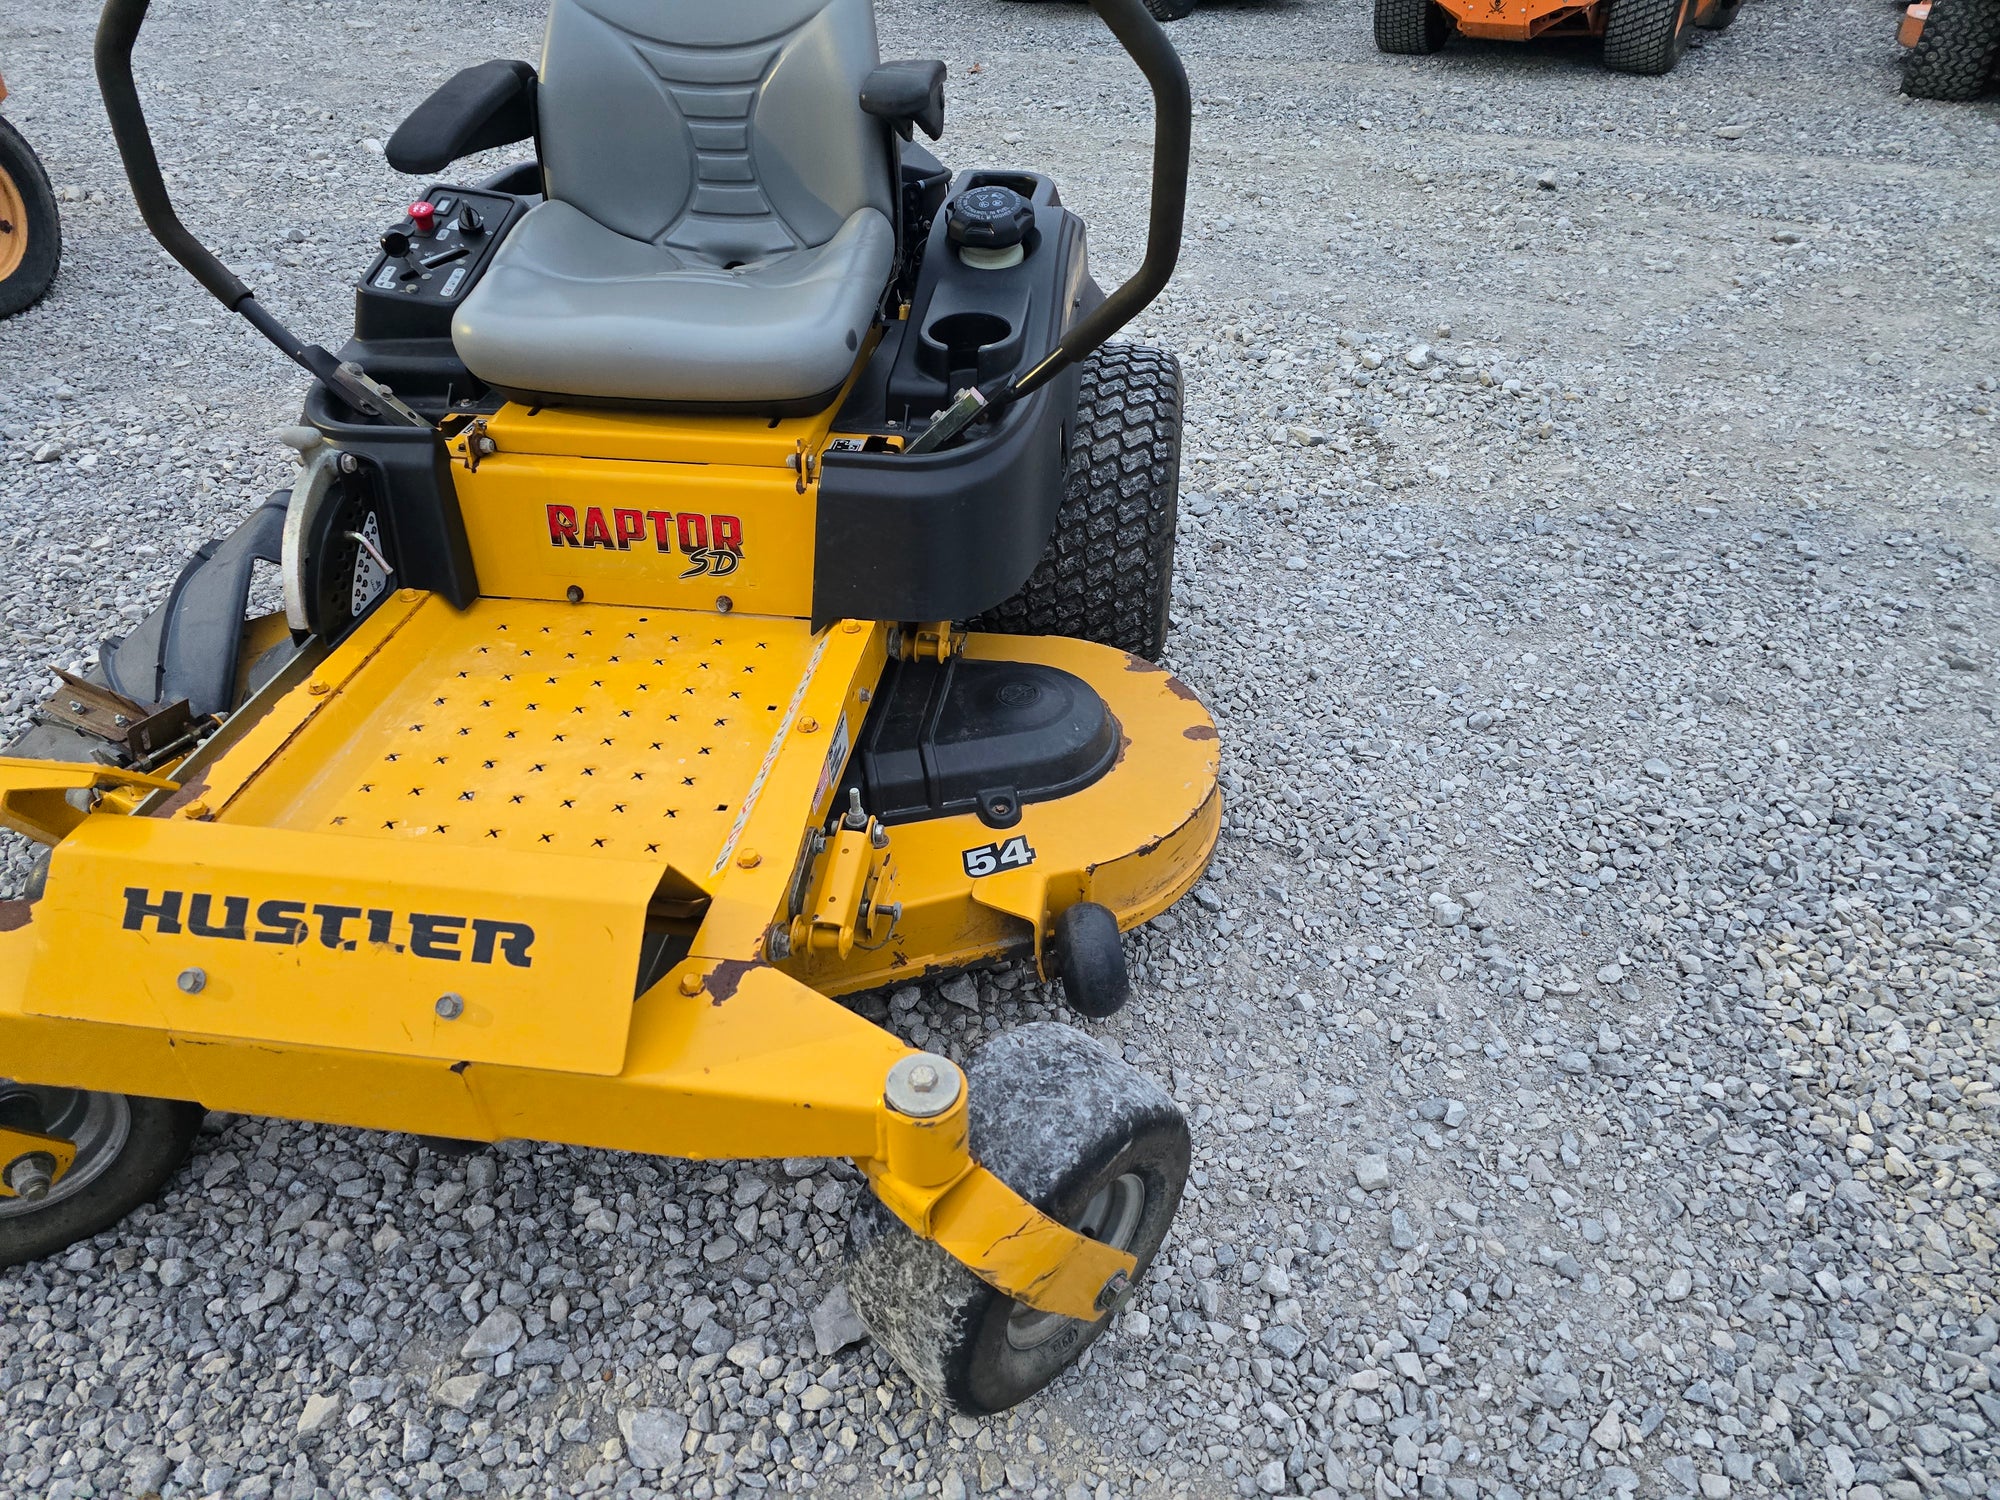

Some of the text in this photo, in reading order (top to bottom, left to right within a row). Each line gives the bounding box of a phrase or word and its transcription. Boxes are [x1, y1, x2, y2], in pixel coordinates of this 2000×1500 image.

[545, 503, 745, 558] RAPTOR
[679, 547, 739, 579] SD
[966, 838, 1032, 876] 54
[122, 887, 535, 968] HUSTLER
